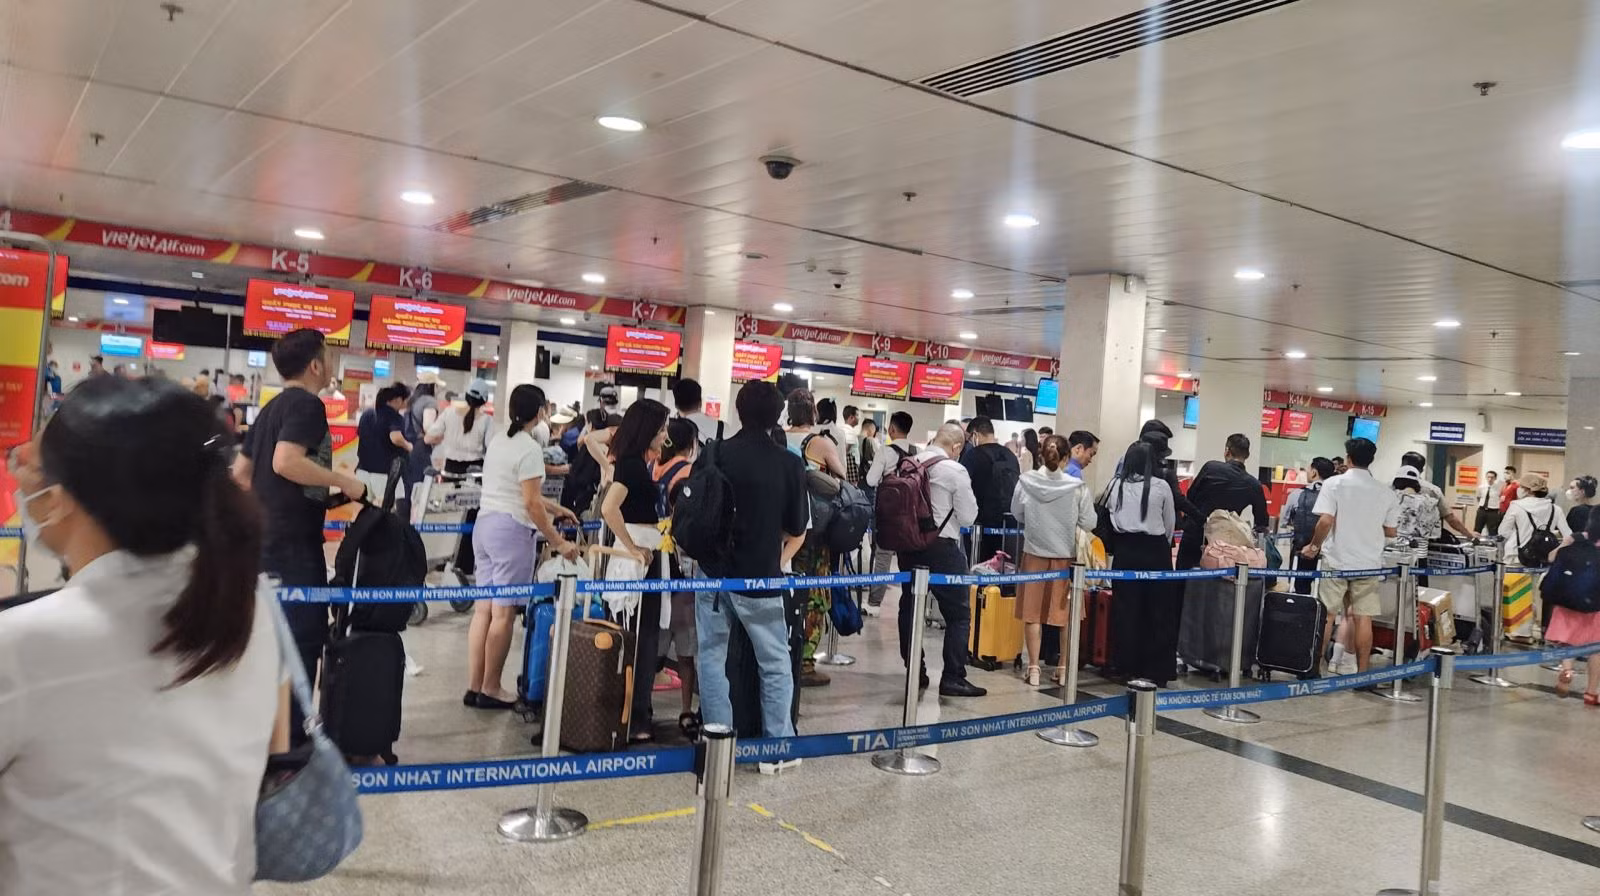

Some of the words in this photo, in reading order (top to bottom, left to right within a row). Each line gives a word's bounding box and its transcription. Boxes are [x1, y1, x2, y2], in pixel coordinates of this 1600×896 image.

[271, 248, 309, 273] K-5
[399, 267, 433, 290] K-6
[631, 301, 658, 319] K-7
[735, 316, 759, 334] K-8
[871, 335, 891, 351] K-9
[924, 343, 949, 359] K-10
[744, 578, 766, 590] TIA
[833, 576, 873, 584] INTERNATIONAL
[873, 574, 895, 582] AIRPORT
[945, 575, 963, 584] TIA
[1135, 571, 1149, 579] TIA
[351, 589, 370, 599] TAN
[372, 589, 390, 599] SON
[395, 588, 420, 599] NHAT
[422, 587, 494, 599] INTERNATIONAL
[495, 585, 534, 596] AIRPORT
[1287, 682, 1310, 696] TIA
[940, 728, 958, 739] TAN
[961, 725, 980, 737] SON
[982, 720, 1007, 735] NHAT
[1007, 710, 1072, 729] INTERNATIONAL
[1073, 703, 1108, 717] AIRPORT
[847, 732, 890, 752] TIA
[351, 772, 388, 789] SON
[394, 769, 442, 787] NHAT
[446, 760, 582, 784] INTERNATIONAL
[585, 755, 657, 774] AIRPORT
